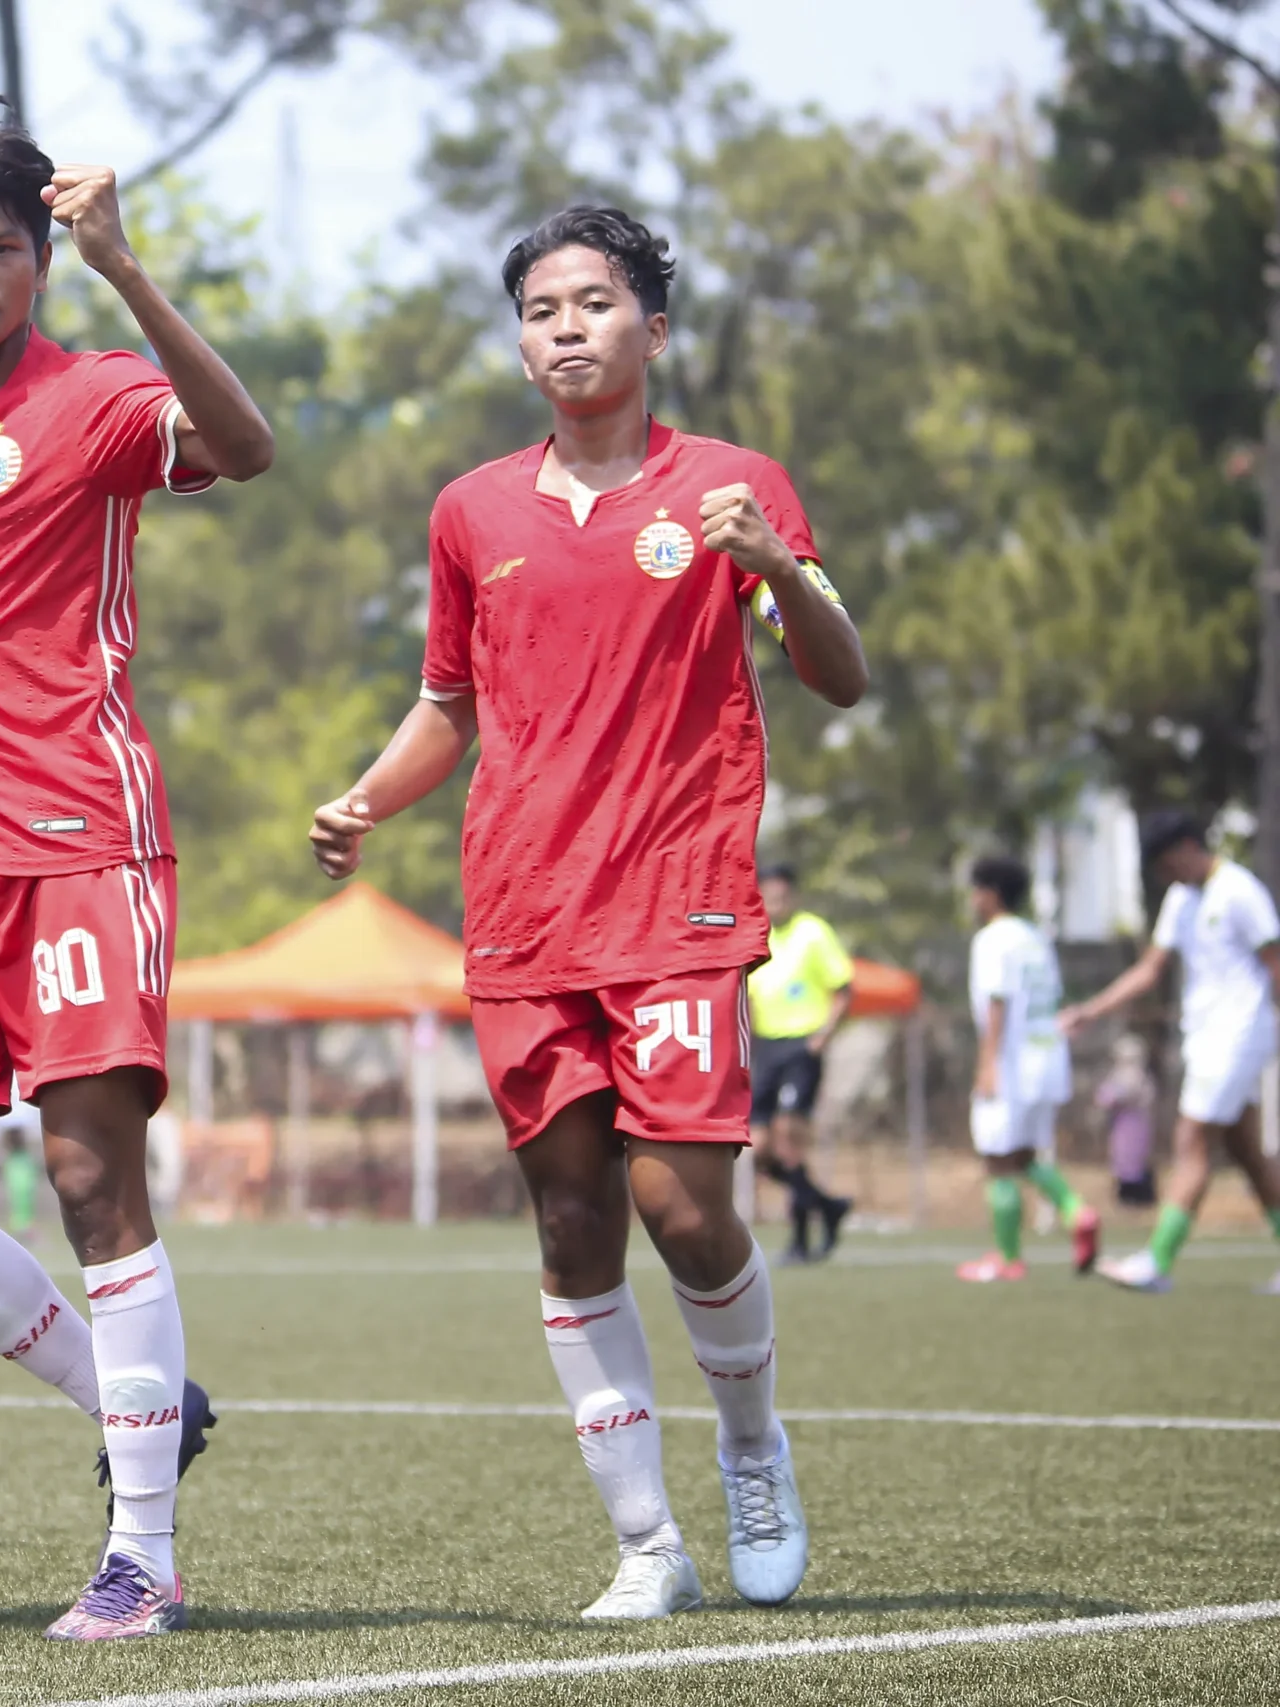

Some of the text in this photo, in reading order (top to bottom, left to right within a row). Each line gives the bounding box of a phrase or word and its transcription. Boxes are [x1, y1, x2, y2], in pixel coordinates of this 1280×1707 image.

[32, 927, 105, 1015] 80
[633, 999, 712, 1073] 74
[1, 1303, 60, 1361] RSIJA
[576, 1408, 650, 1437] RSIJA
